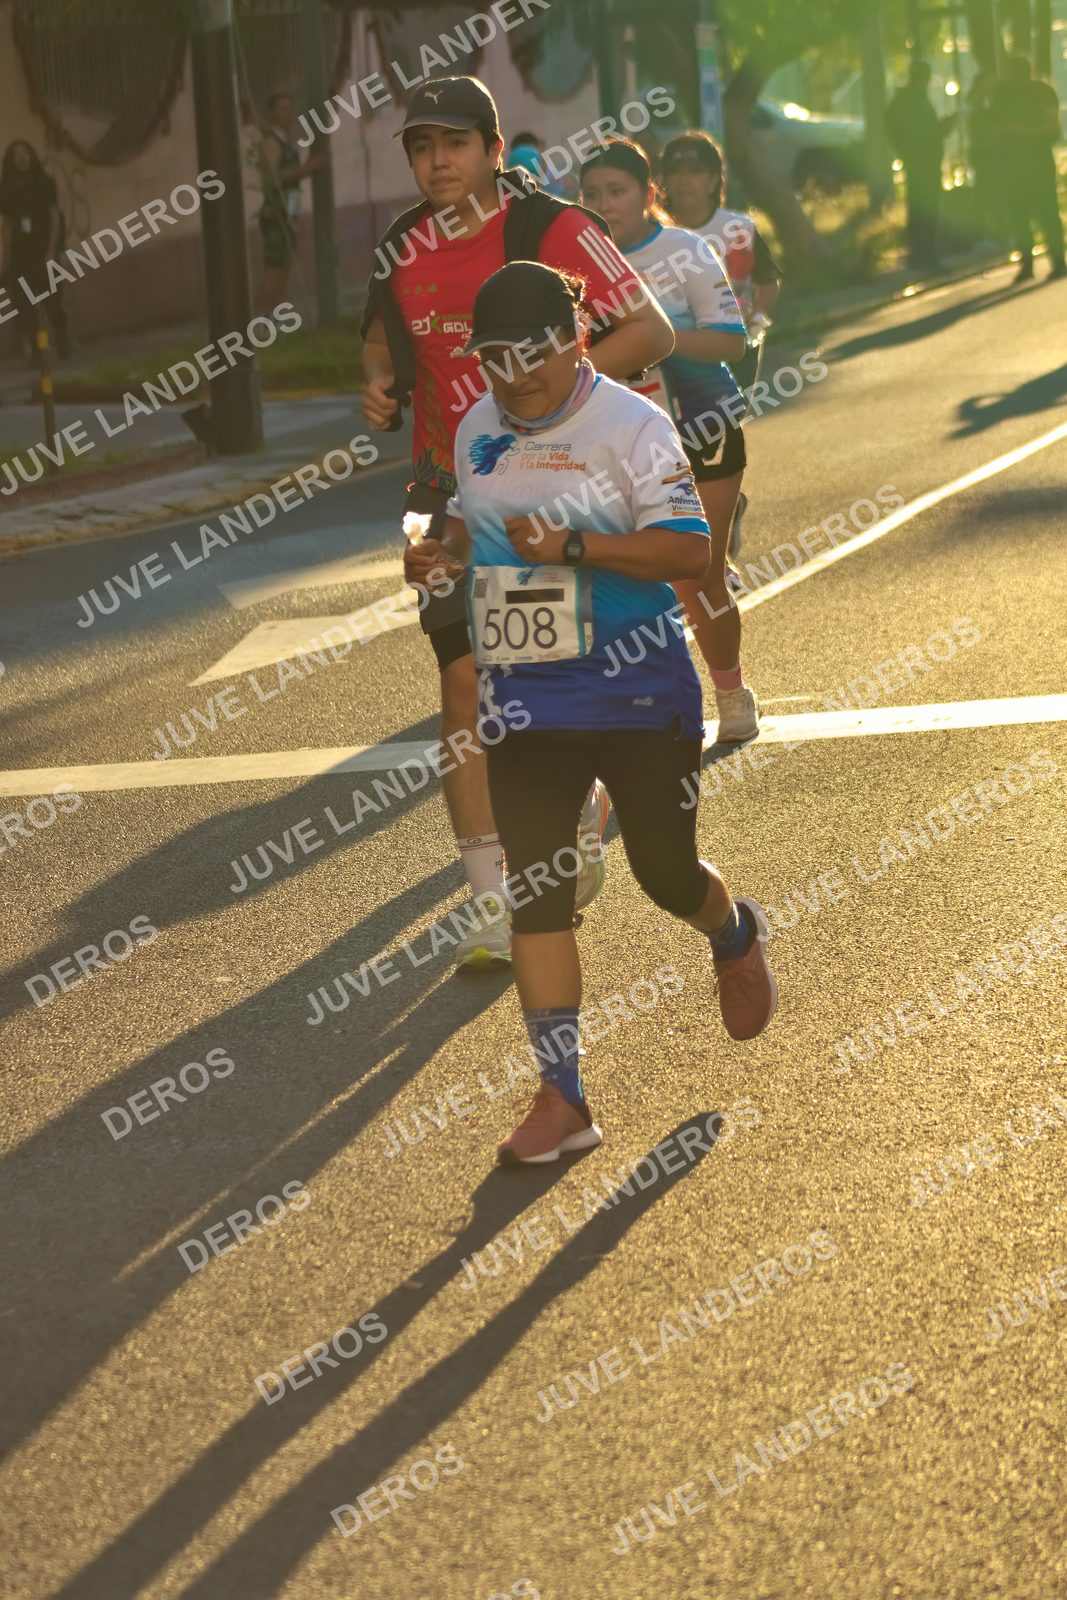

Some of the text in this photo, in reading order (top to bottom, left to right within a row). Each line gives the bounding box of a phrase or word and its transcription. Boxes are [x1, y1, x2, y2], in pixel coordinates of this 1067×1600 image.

[524, 441, 572, 451] Carrera
[549, 452, 570, 461] Vida
[536, 461, 586, 471] Integridad
[481, 606, 558, 651] 508
